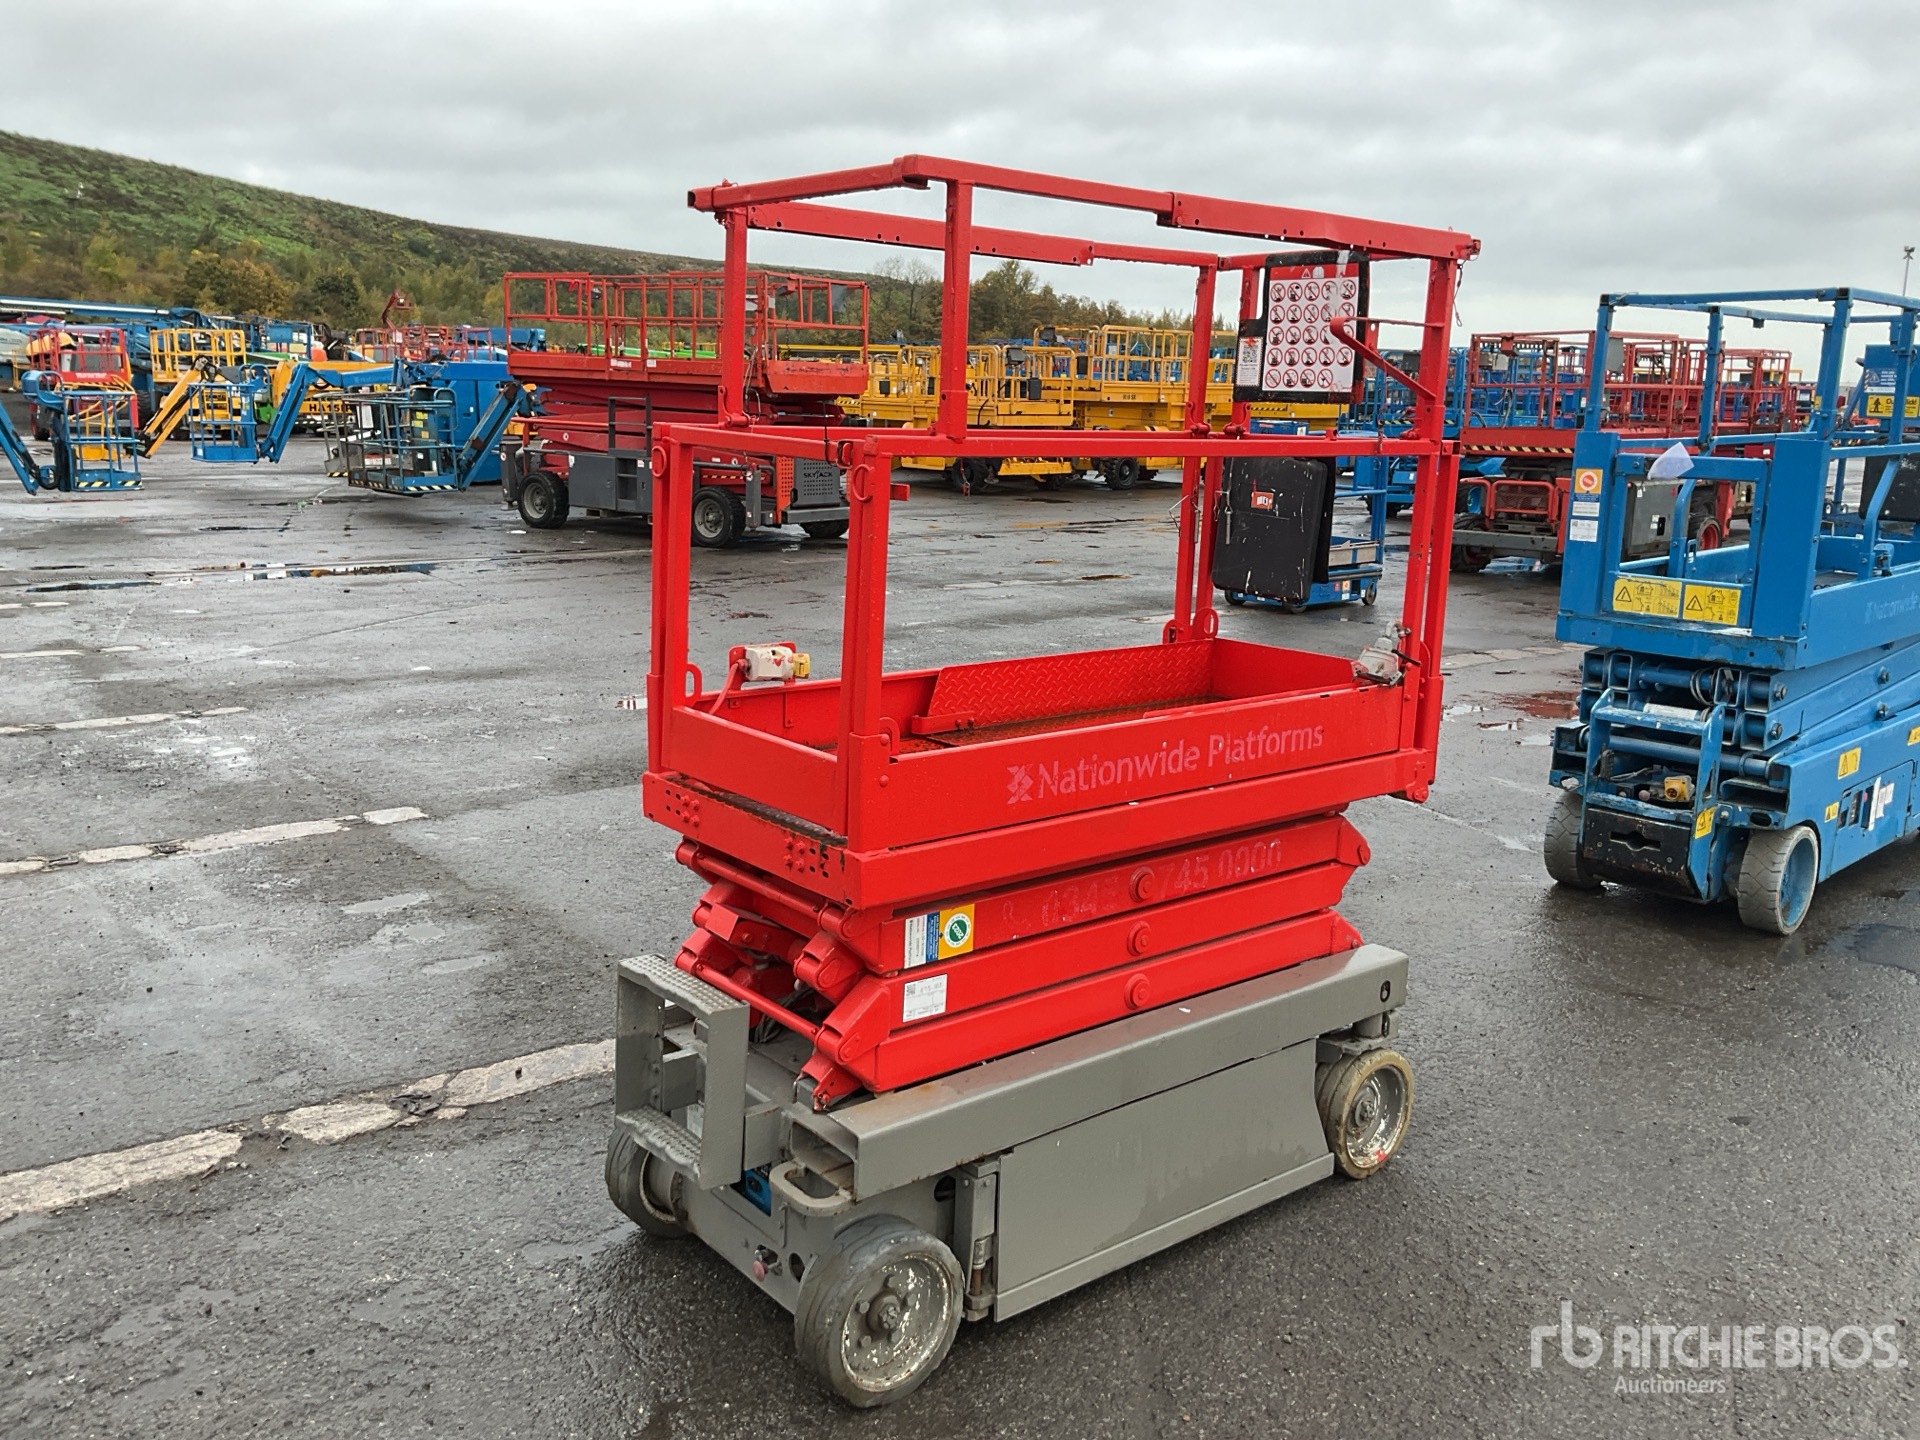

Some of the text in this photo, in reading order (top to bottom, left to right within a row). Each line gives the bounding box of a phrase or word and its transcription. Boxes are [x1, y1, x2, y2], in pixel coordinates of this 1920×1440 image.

[803, 470, 832, 479] SKYJACK
[1037, 725, 1323, 799] Nationwide Platforms
